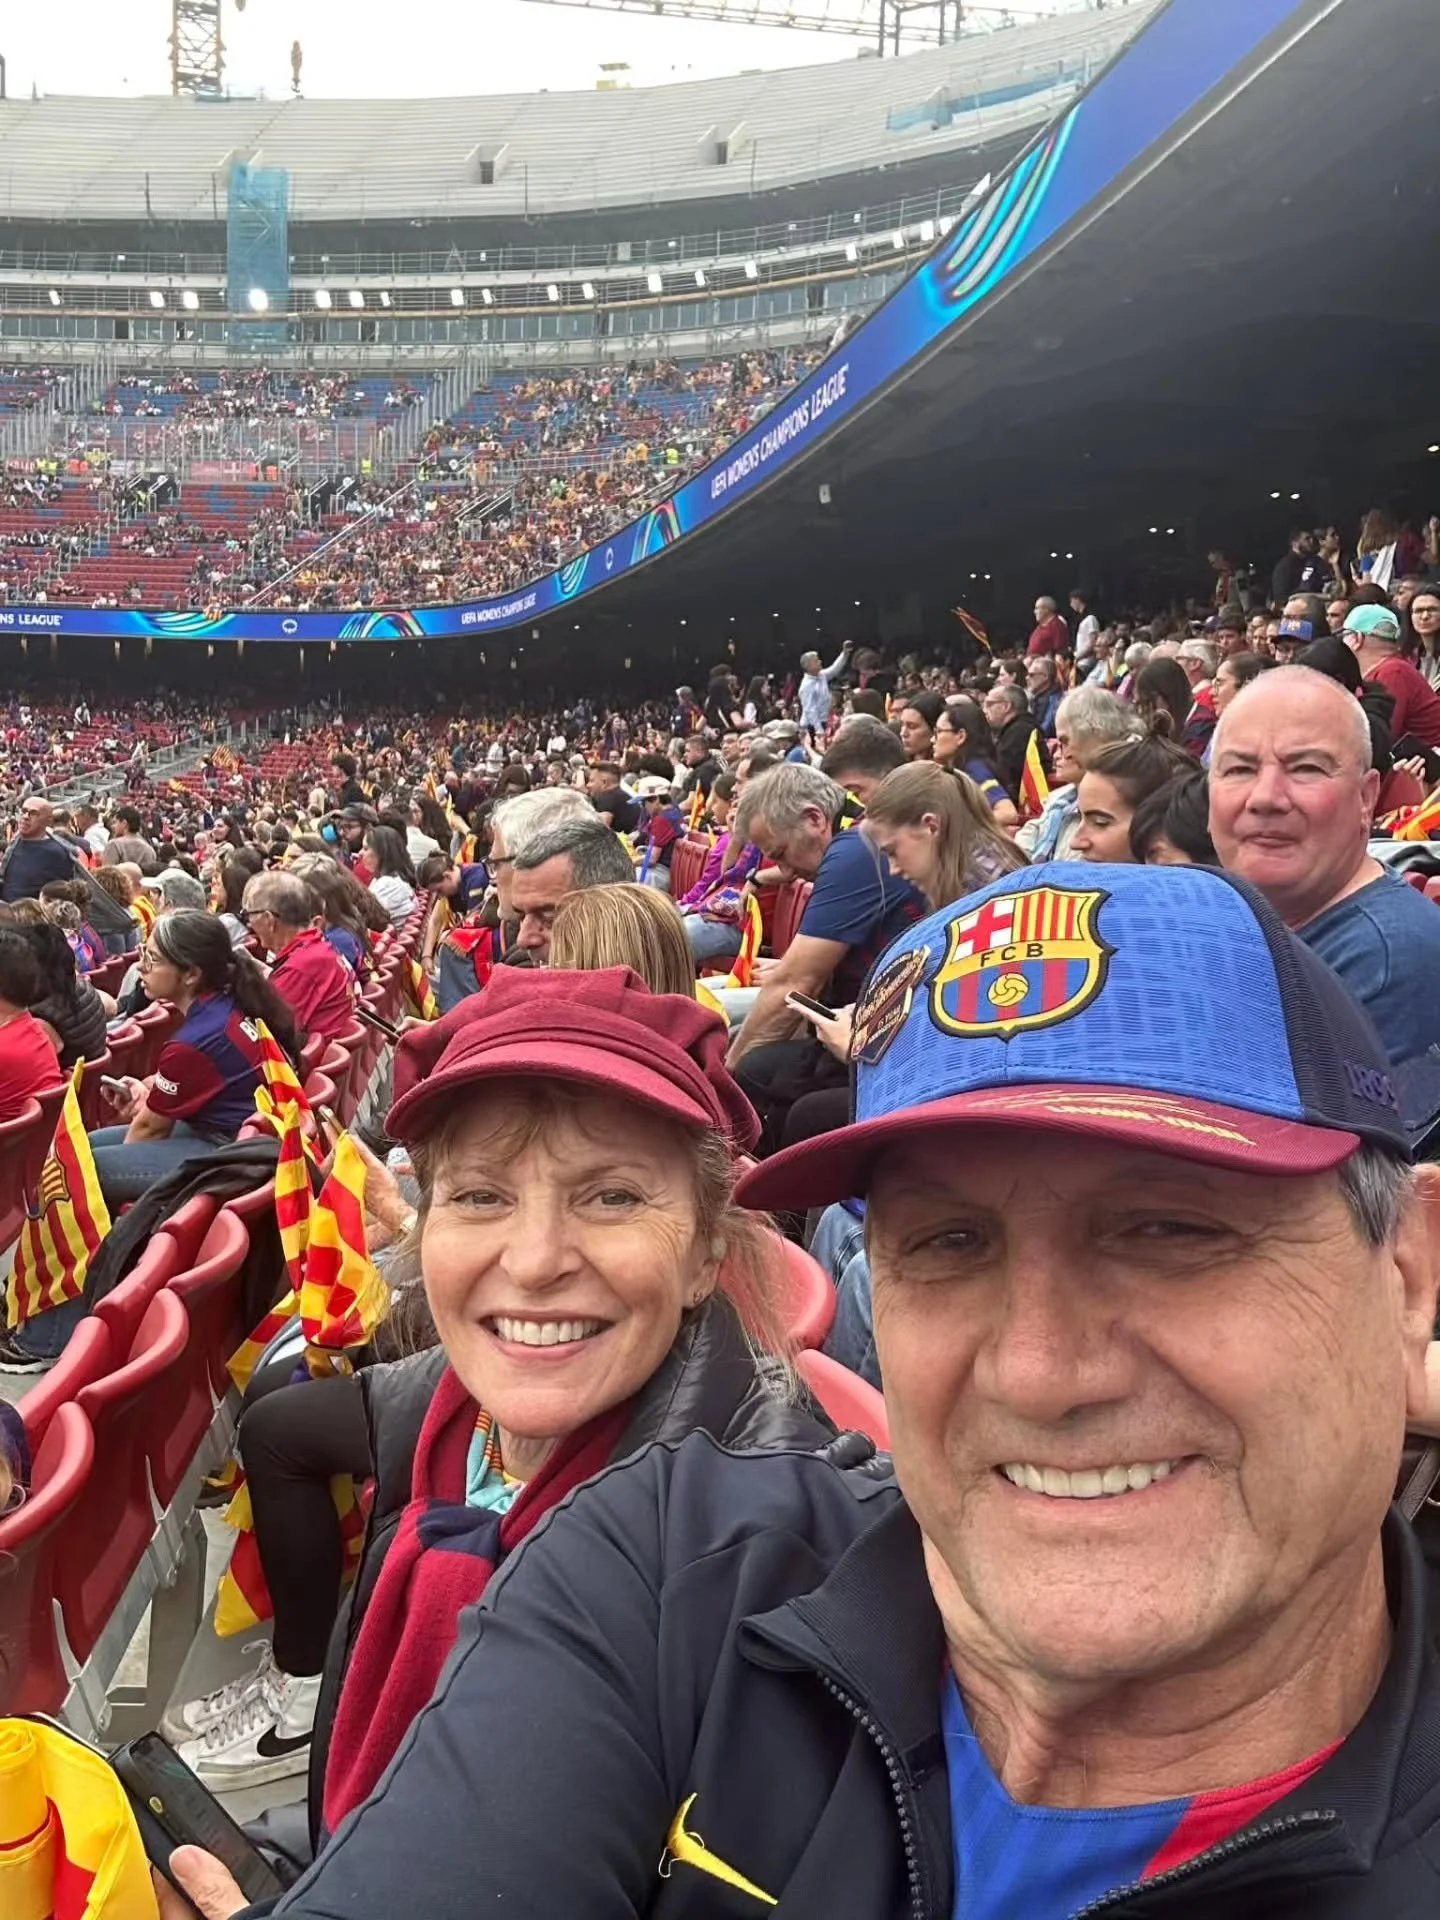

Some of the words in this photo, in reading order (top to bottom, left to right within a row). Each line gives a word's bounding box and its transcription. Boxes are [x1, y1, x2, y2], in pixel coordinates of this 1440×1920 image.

[712, 470, 727, 499] UEFA
[760, 400, 809, 462] CHAMPIONS
[810, 363, 849, 421] LEAGUE
[18, 614, 61, 626] LEAGUE
